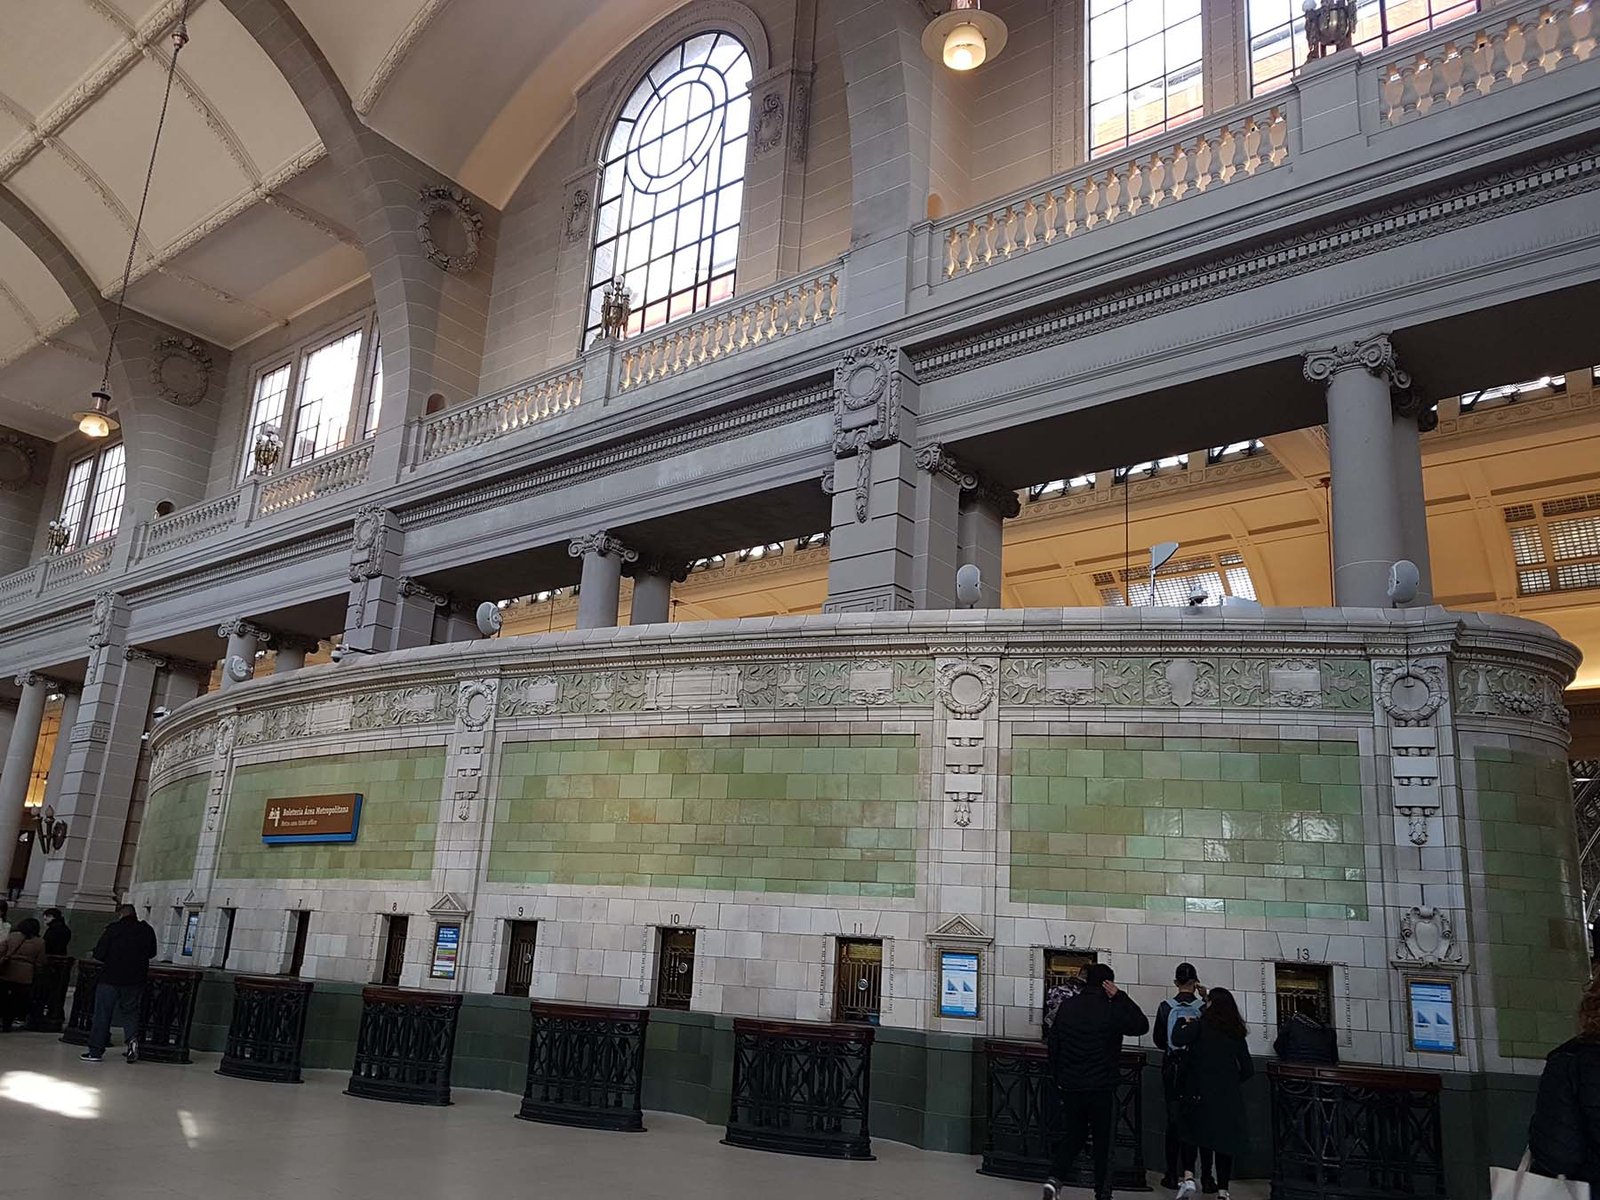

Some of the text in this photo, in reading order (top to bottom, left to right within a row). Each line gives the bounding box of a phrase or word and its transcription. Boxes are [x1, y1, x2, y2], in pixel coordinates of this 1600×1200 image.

[316, 805, 349, 816] Metropolitana
[298, 899, 302, 908] 7
[392, 902, 398, 912] 8
[518, 906, 524, 917] 9
[670, 914, 680, 924] 10
[854, 922, 862, 934] 11
[1063, 934, 1076, 947] 12
[1296, 948, 1310, 960] 13
